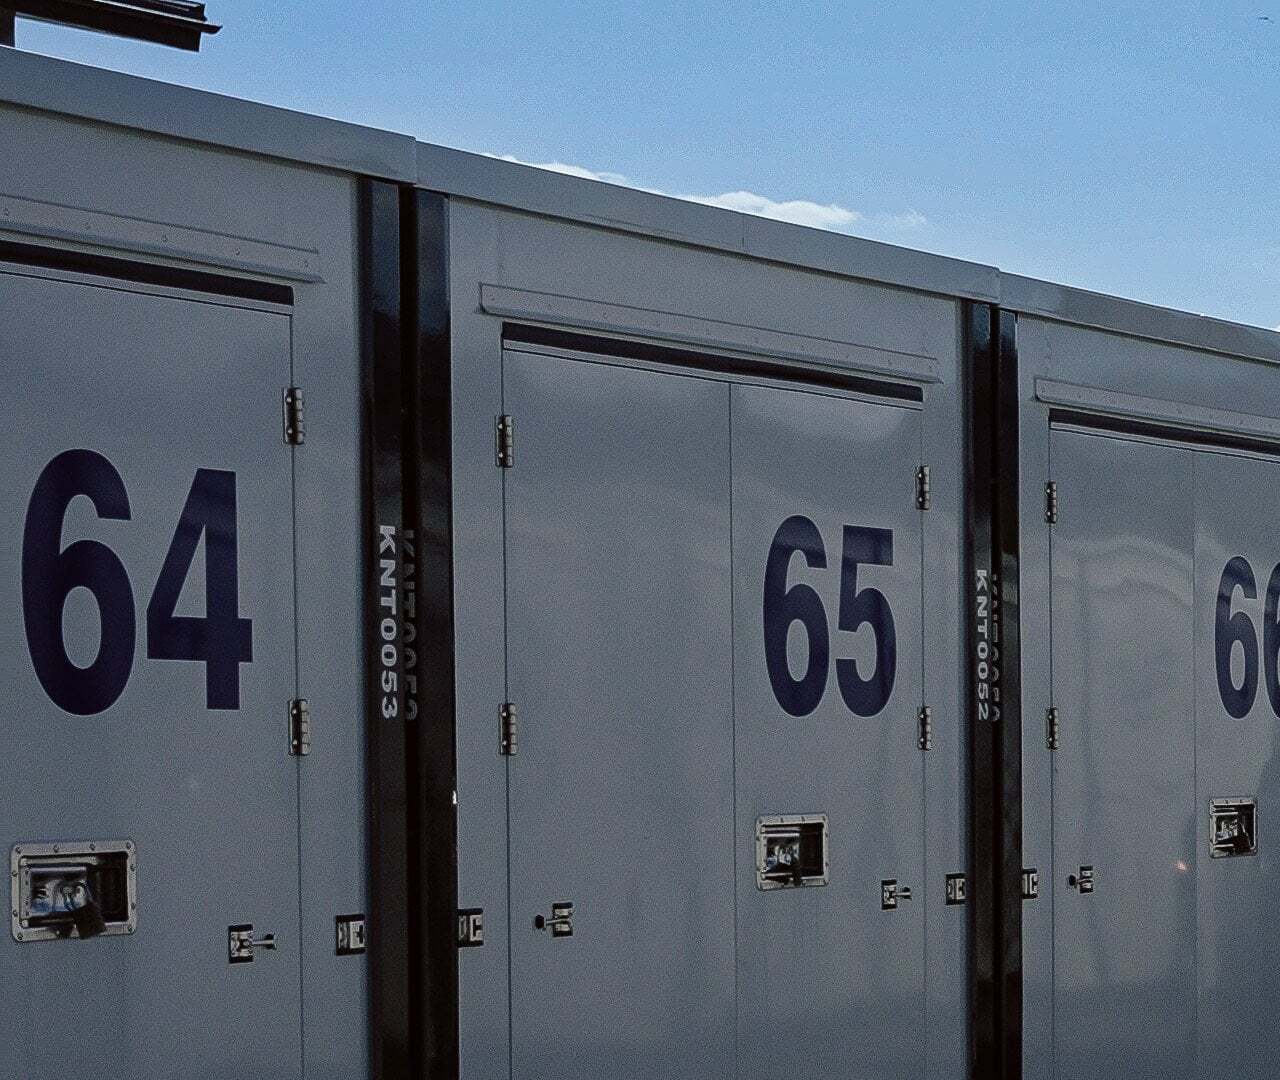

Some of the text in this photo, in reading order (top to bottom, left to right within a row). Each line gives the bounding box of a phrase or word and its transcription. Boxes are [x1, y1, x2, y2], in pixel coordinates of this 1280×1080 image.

[22, 449, 253, 716] 64
[379, 525, 398, 719] KNT0053
[763, 515, 897, 717] 65
[976, 569, 990, 721] KNT0052
